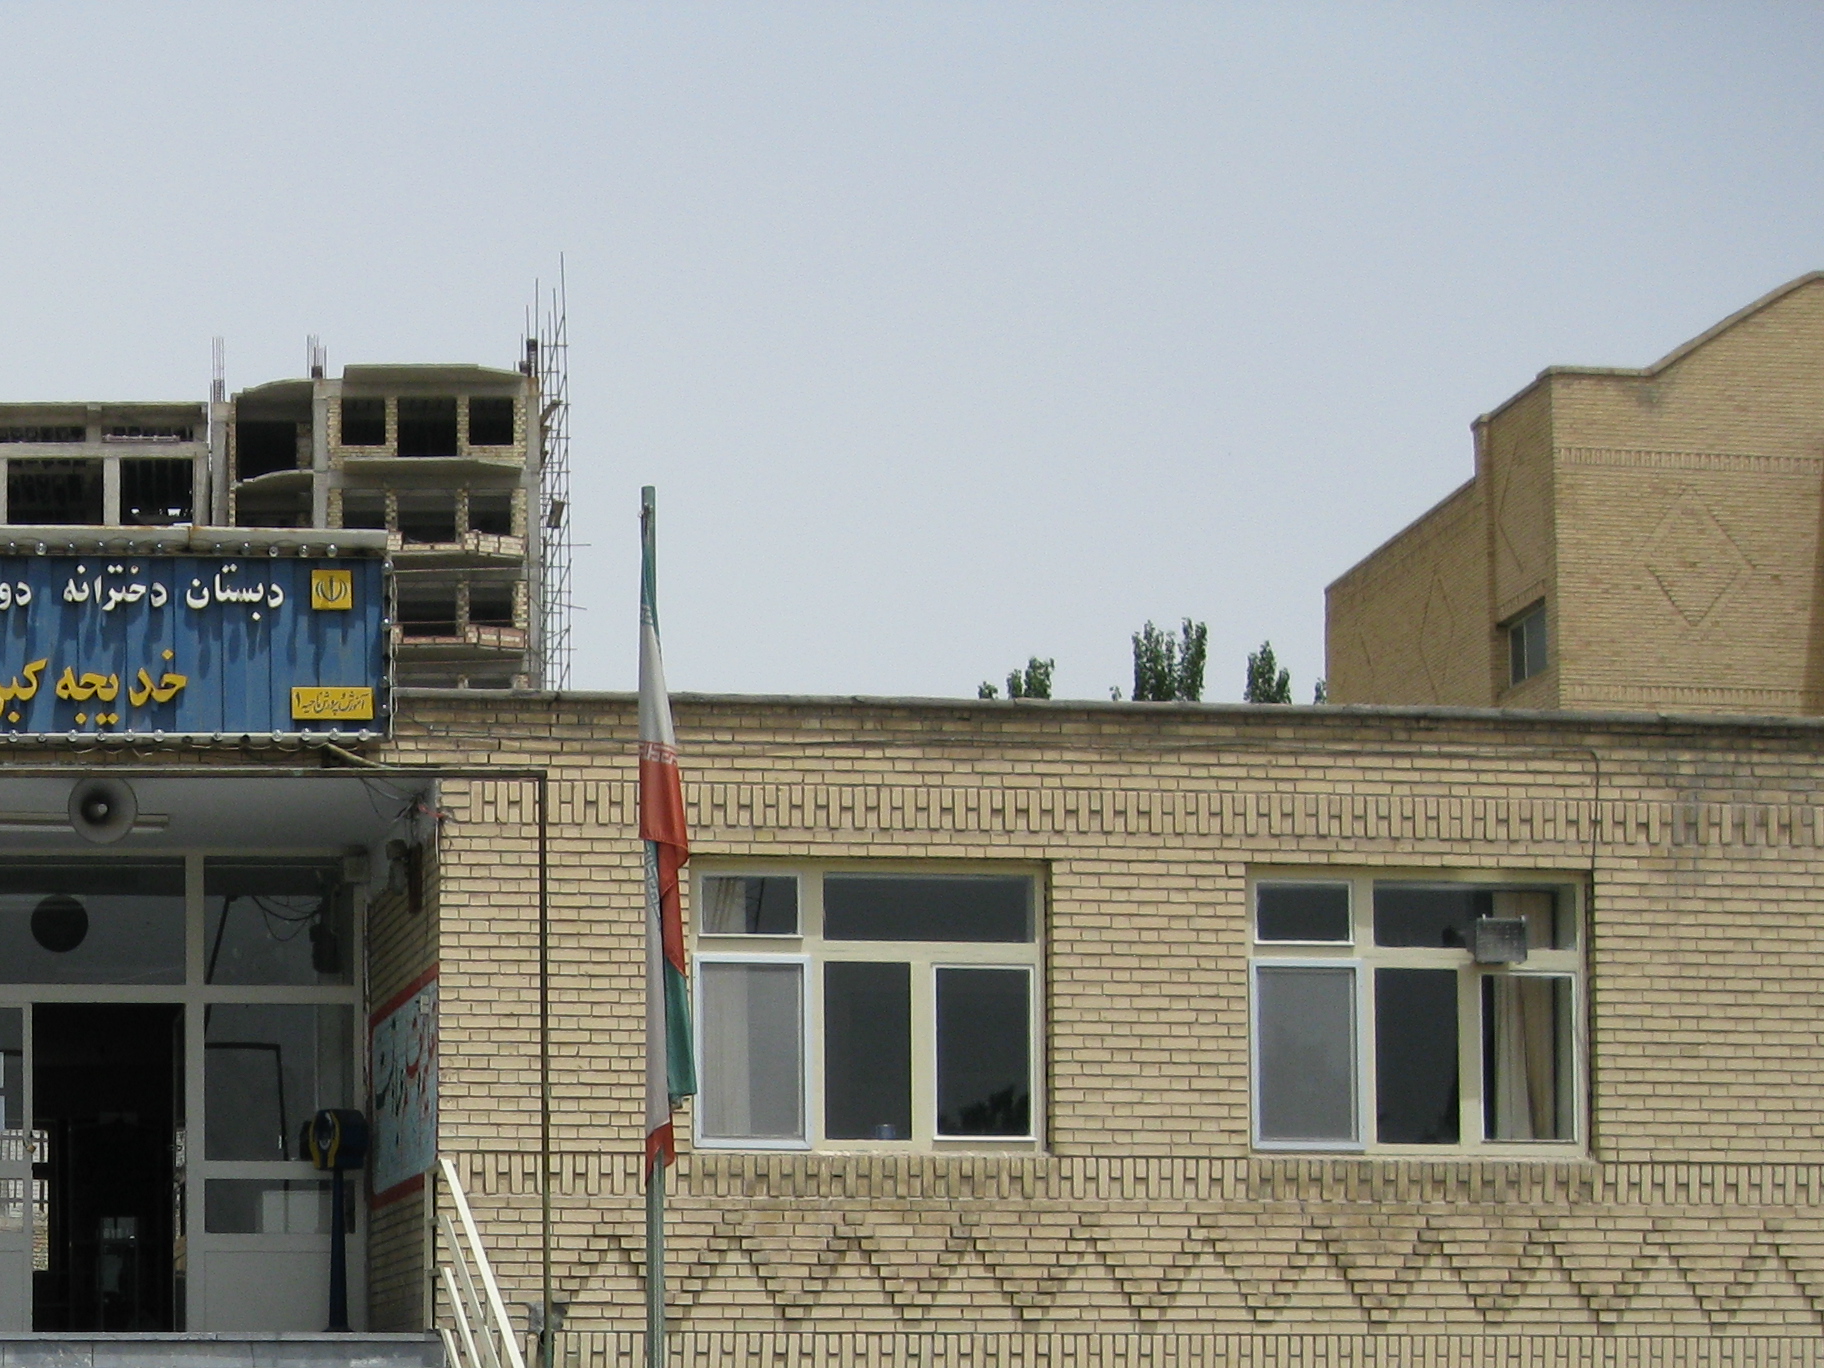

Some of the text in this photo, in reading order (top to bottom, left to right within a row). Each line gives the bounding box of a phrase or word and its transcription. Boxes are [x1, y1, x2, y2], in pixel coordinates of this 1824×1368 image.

[63, 563, 169, 612] دخترانه
[186, 563, 284, 621] دبستان
[52, 649, 188, 725] خدیجه
